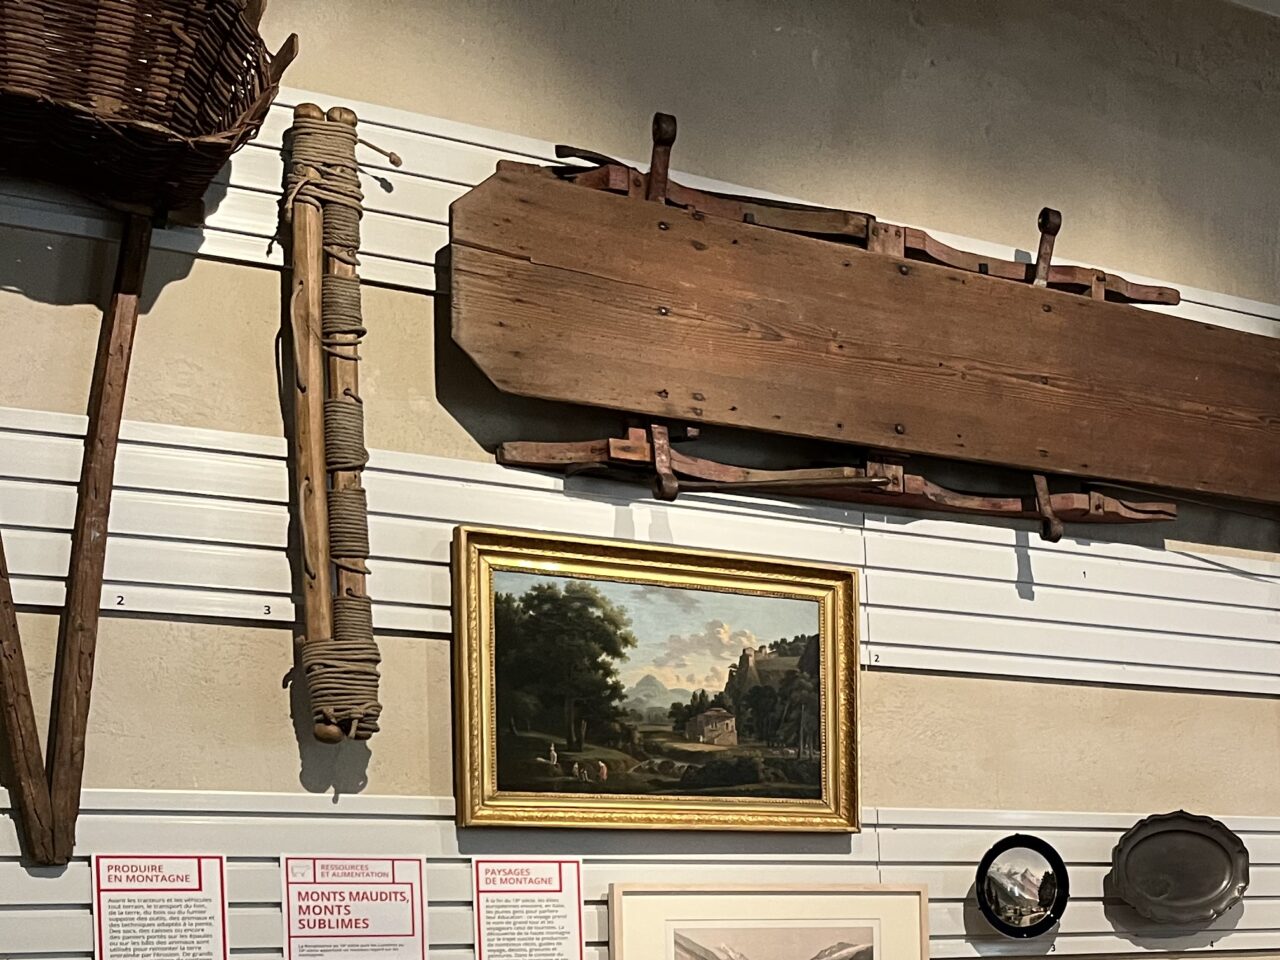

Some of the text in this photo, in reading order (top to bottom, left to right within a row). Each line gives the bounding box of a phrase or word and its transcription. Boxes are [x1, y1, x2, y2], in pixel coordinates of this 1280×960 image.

[116, 596, 124, 605] 2
[263, 605, 271, 614] 3
[874, 655, 880, 663] 2
[107, 865, 164, 873] PRODUIRE
[485, 868, 530, 876] PAYSAGES
[108, 874, 191, 883] EN MONTAGNE
[499, 877, 553, 885] MONTAGNE
[298, 891, 409, 903] MONTS MAUDITS,
[298, 905, 351, 915] MONTS
[298, 918, 369, 929] SUBLIMES
